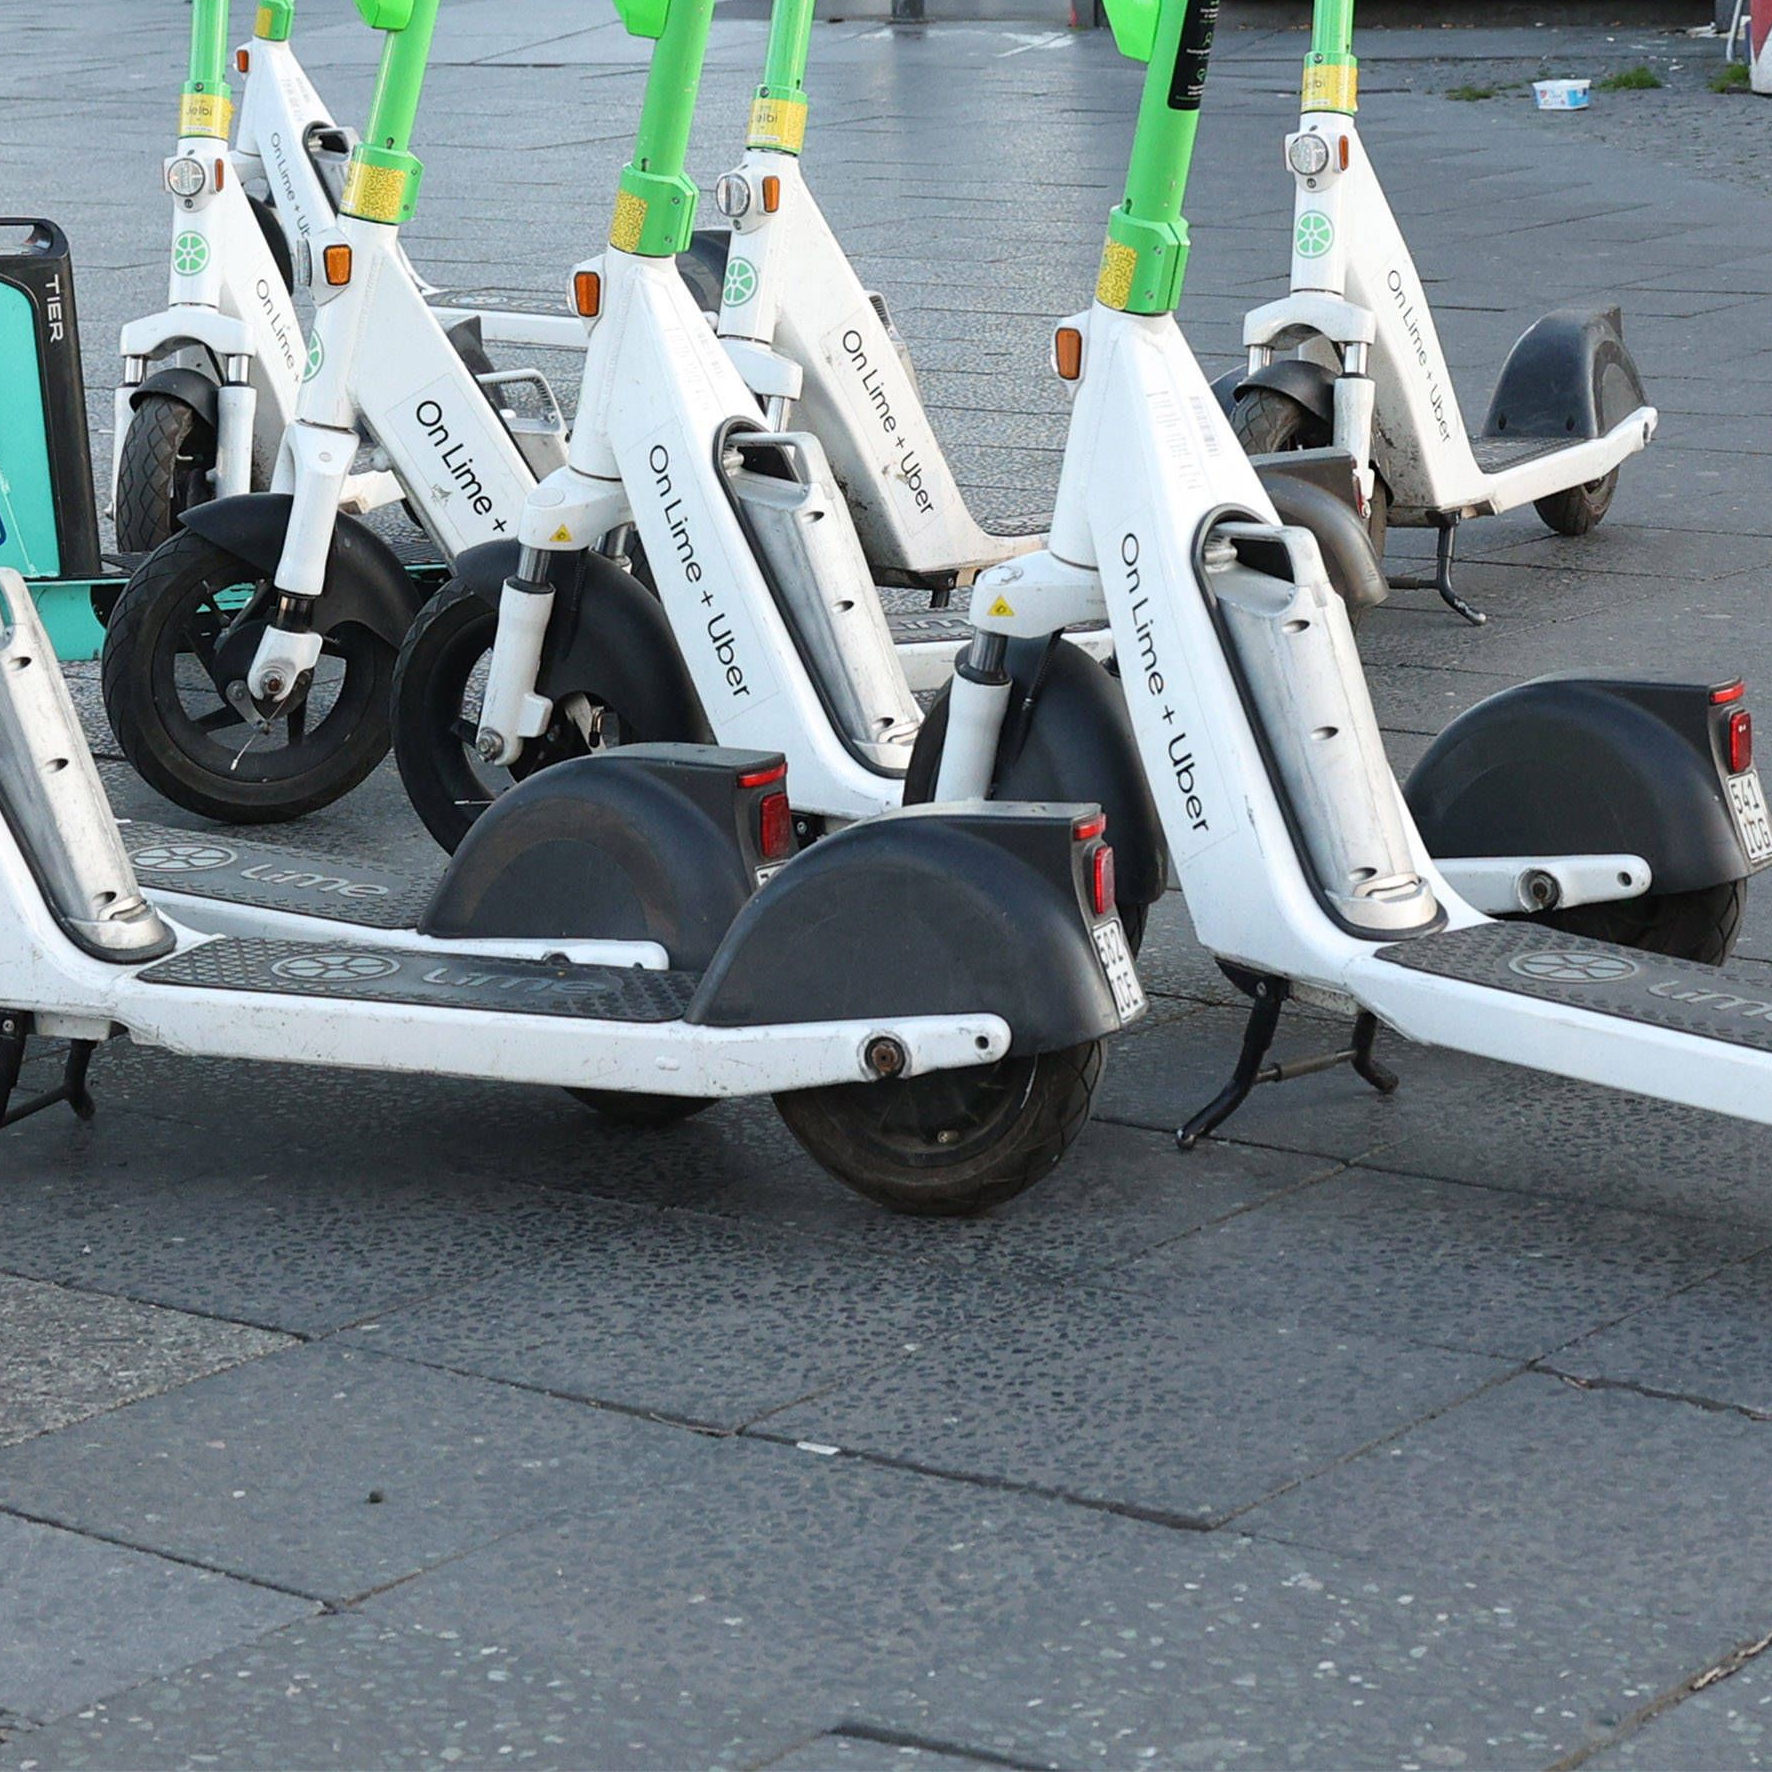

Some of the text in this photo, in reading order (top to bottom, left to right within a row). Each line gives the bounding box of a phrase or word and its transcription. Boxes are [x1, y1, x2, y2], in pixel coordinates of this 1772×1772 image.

[271, 131, 284, 157] On
[276, 158, 298, 201] Lime
[43, 272, 66, 346] TIER
[256, 278, 271, 312] On
[263, 313, 291, 371] Lime
[1387, 268, 1408, 306] On
[1399, 308, 1427, 364] Lime
[1429, 384, 1452, 443] Uber
[842, 328, 867, 370] On
[860, 371, 897, 433] Lime
[902, 448, 936, 516] Uber
[415, 399, 448, 449] On
[441, 447, 495, 518] Lime
[648, 443, 677, 495] On
[663, 498, 703, 584] Lime
[708, 613, 750, 700] Uber
[1120, 531, 1142, 601] On
[1131, 599, 1164, 695] Lime
[1167, 732, 1211, 834] Uber
[1730, 778, 1760, 815] 541
[240, 862, 391, 902] Lime
[419, 965, 614, 999] Lime
